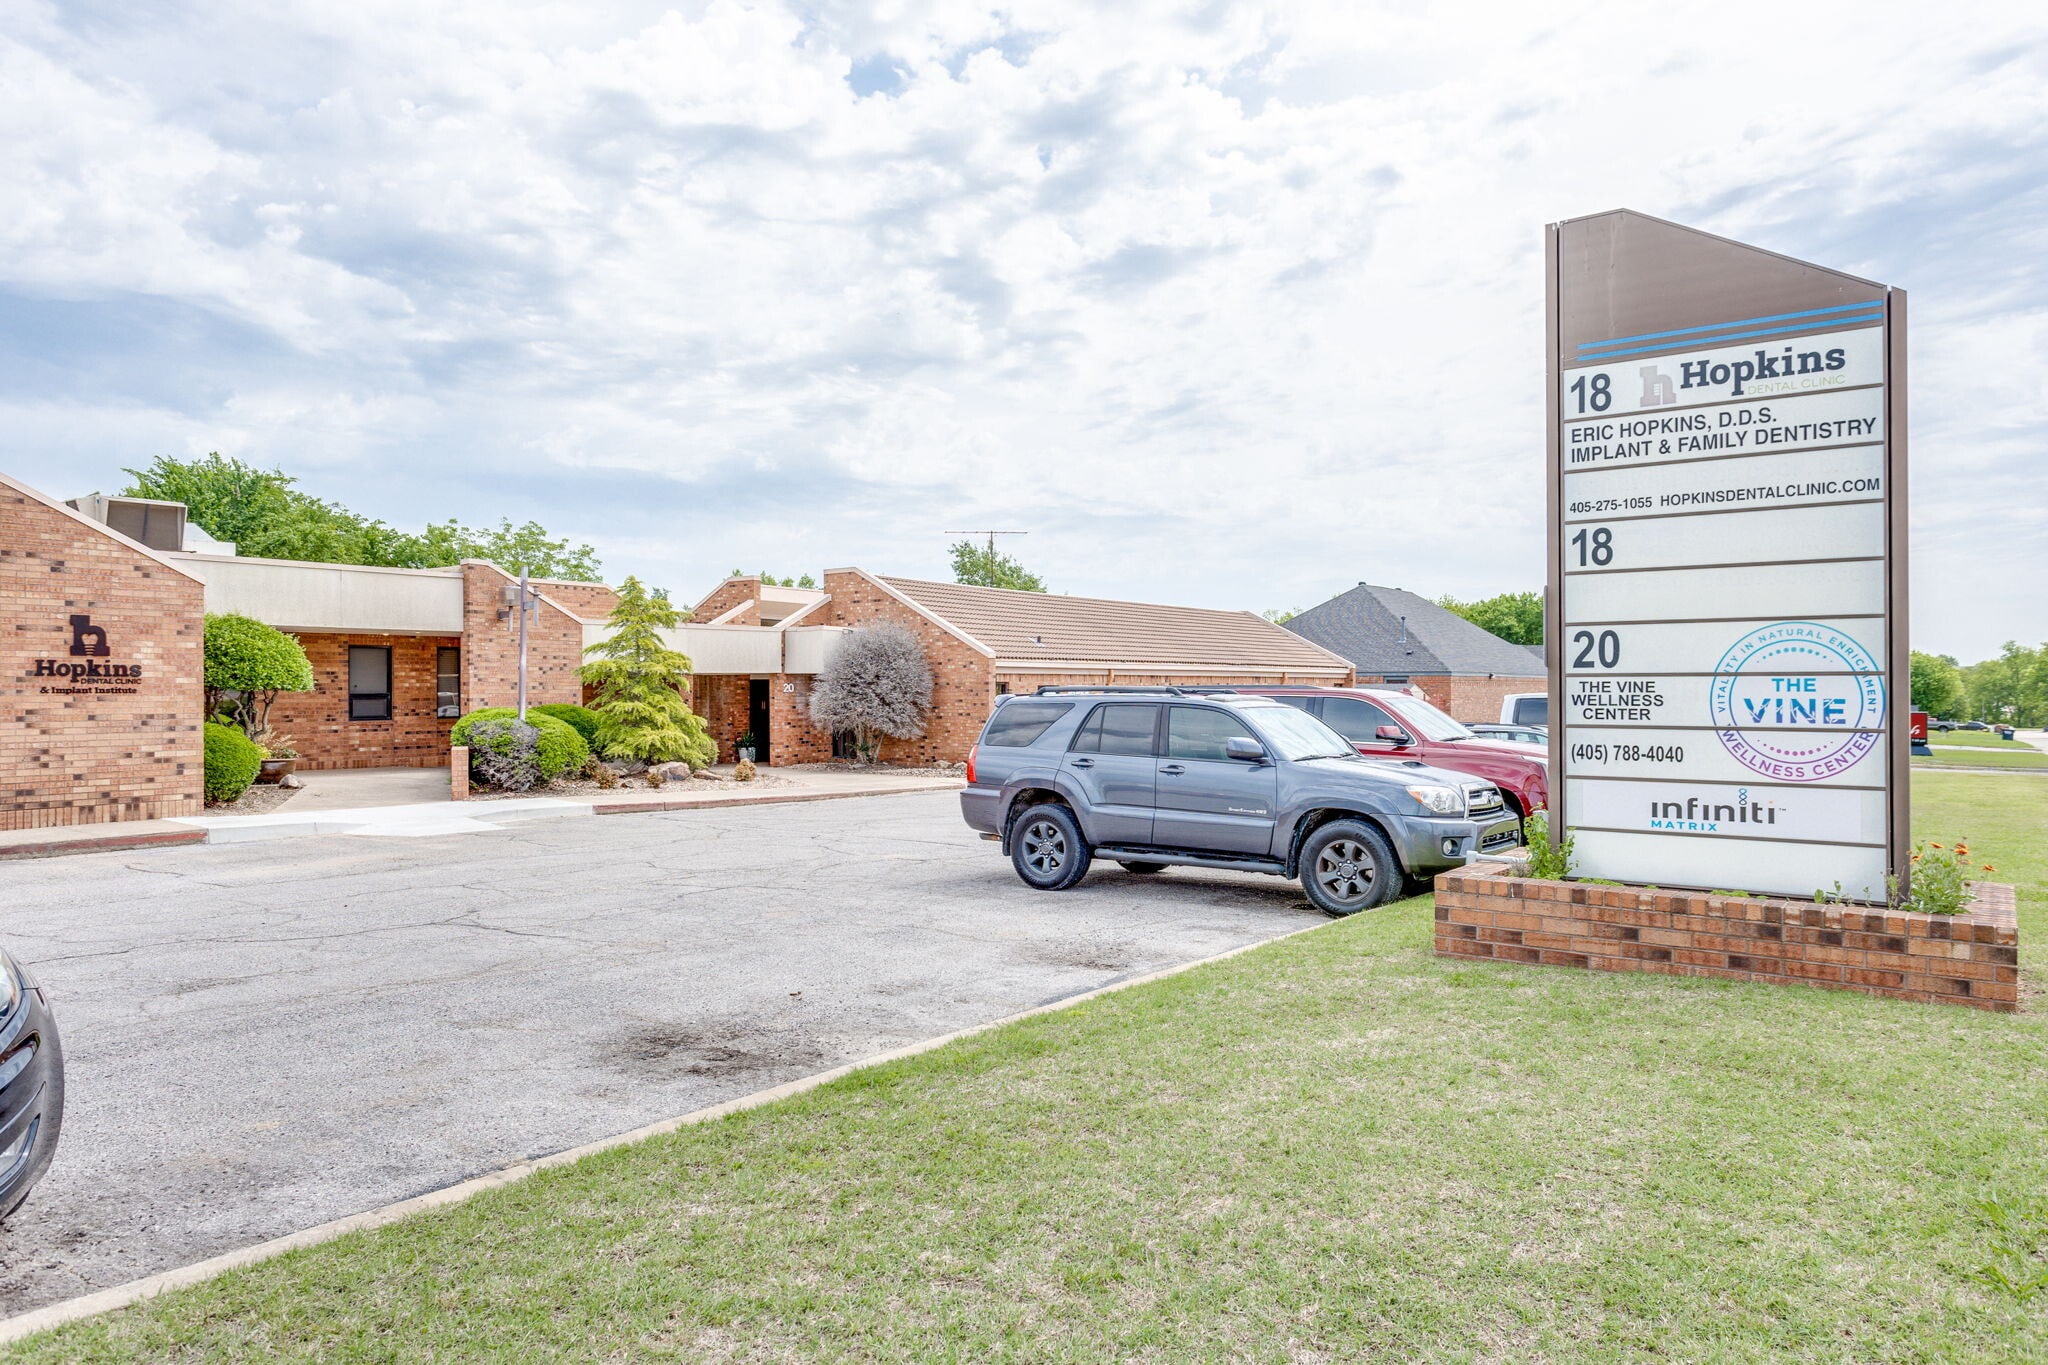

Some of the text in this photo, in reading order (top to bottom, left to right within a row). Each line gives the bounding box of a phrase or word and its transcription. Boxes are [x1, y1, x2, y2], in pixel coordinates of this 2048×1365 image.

[1680, 346, 1846, 397] Hopkins
[1747, 374, 1847, 396] DENTAL CLINIC
[1570, 373, 1612, 414] 18
[1571, 407, 1777, 444] ERIC HOPKINS, D.D.S.
[1571, 417, 1877, 463] IMPLANT & FAMILY DENTISTRY
[1569, 478, 1880, 514] 405-275-1055 HOPKINSDENTALCLINIC.COM
[1572, 527, 1614, 567] 18
[1572, 629, 1620, 669] 20
[34, 659, 142, 683] Hopkins
[1740, 642, 1754, 654] IN
[1758, 628, 1823, 644] NATURAL
[1828, 636, 1877, 714] ENRICHMENT
[40, 686, 137, 695] & Implant Institute
[783, 683, 795, 693] 20
[1579, 681, 1656, 693] THE VINE
[1771, 678, 1817, 693] THE
[1571, 694, 1664, 707] WELLNESS
[1743, 698, 1847, 725] VINE
[1582, 708, 1651, 721] CENTER
[1571, 743, 1684, 765] (405) 788-4040
[1723, 724, 1874, 778] WELLNESS CENTER
[1651, 788, 1776, 825] infiniti
[1651, 820, 1717, 832] MATRIX
